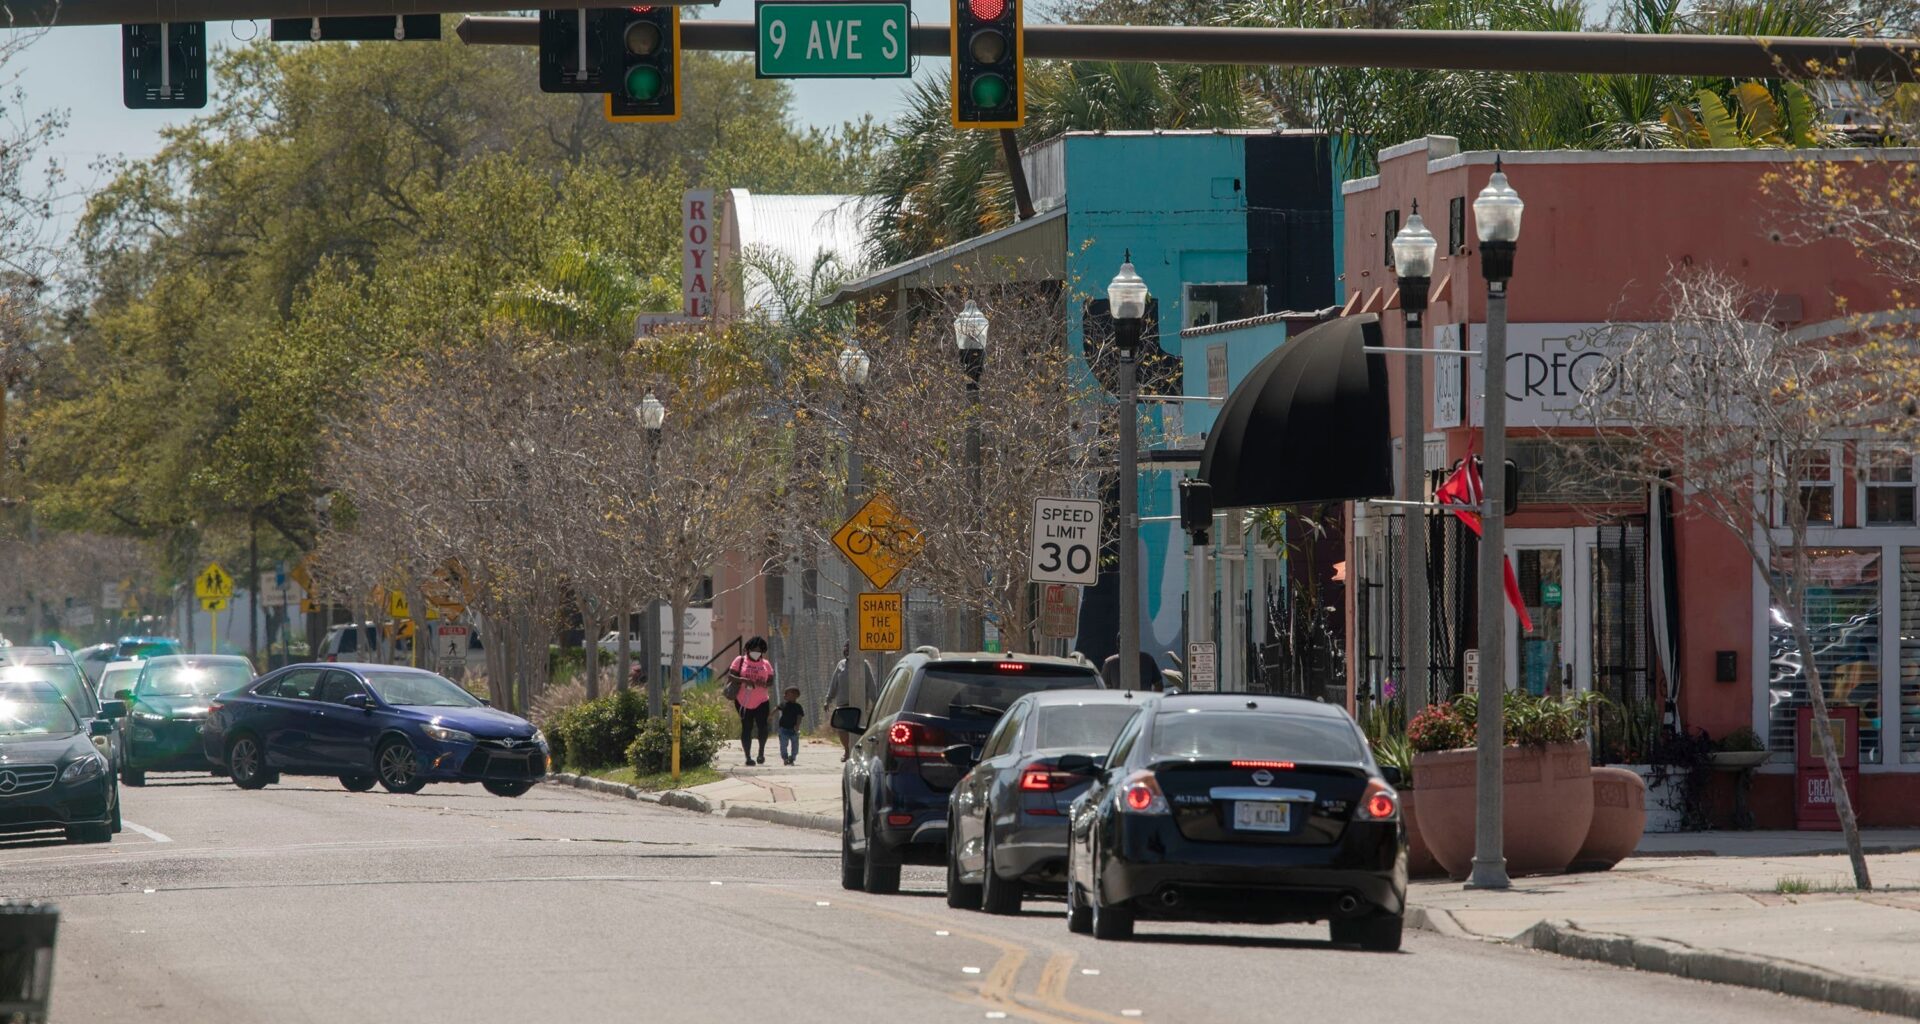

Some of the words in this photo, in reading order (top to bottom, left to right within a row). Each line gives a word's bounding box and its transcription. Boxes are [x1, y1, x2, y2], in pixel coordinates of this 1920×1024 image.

[769, 19, 787, 60] 9
[805, 20, 863, 60] AVE
[881, 18, 899, 60] S
[688, 200, 708, 318] ROYAL
[1041, 507, 1094, 523] SPEED
[1046, 524, 1087, 539] LIMIT
[1037, 542, 1092, 575] 30
[863, 600, 898, 612] SHARE
[870, 616, 890, 628] THE
[866, 632, 895, 644] ROAD
